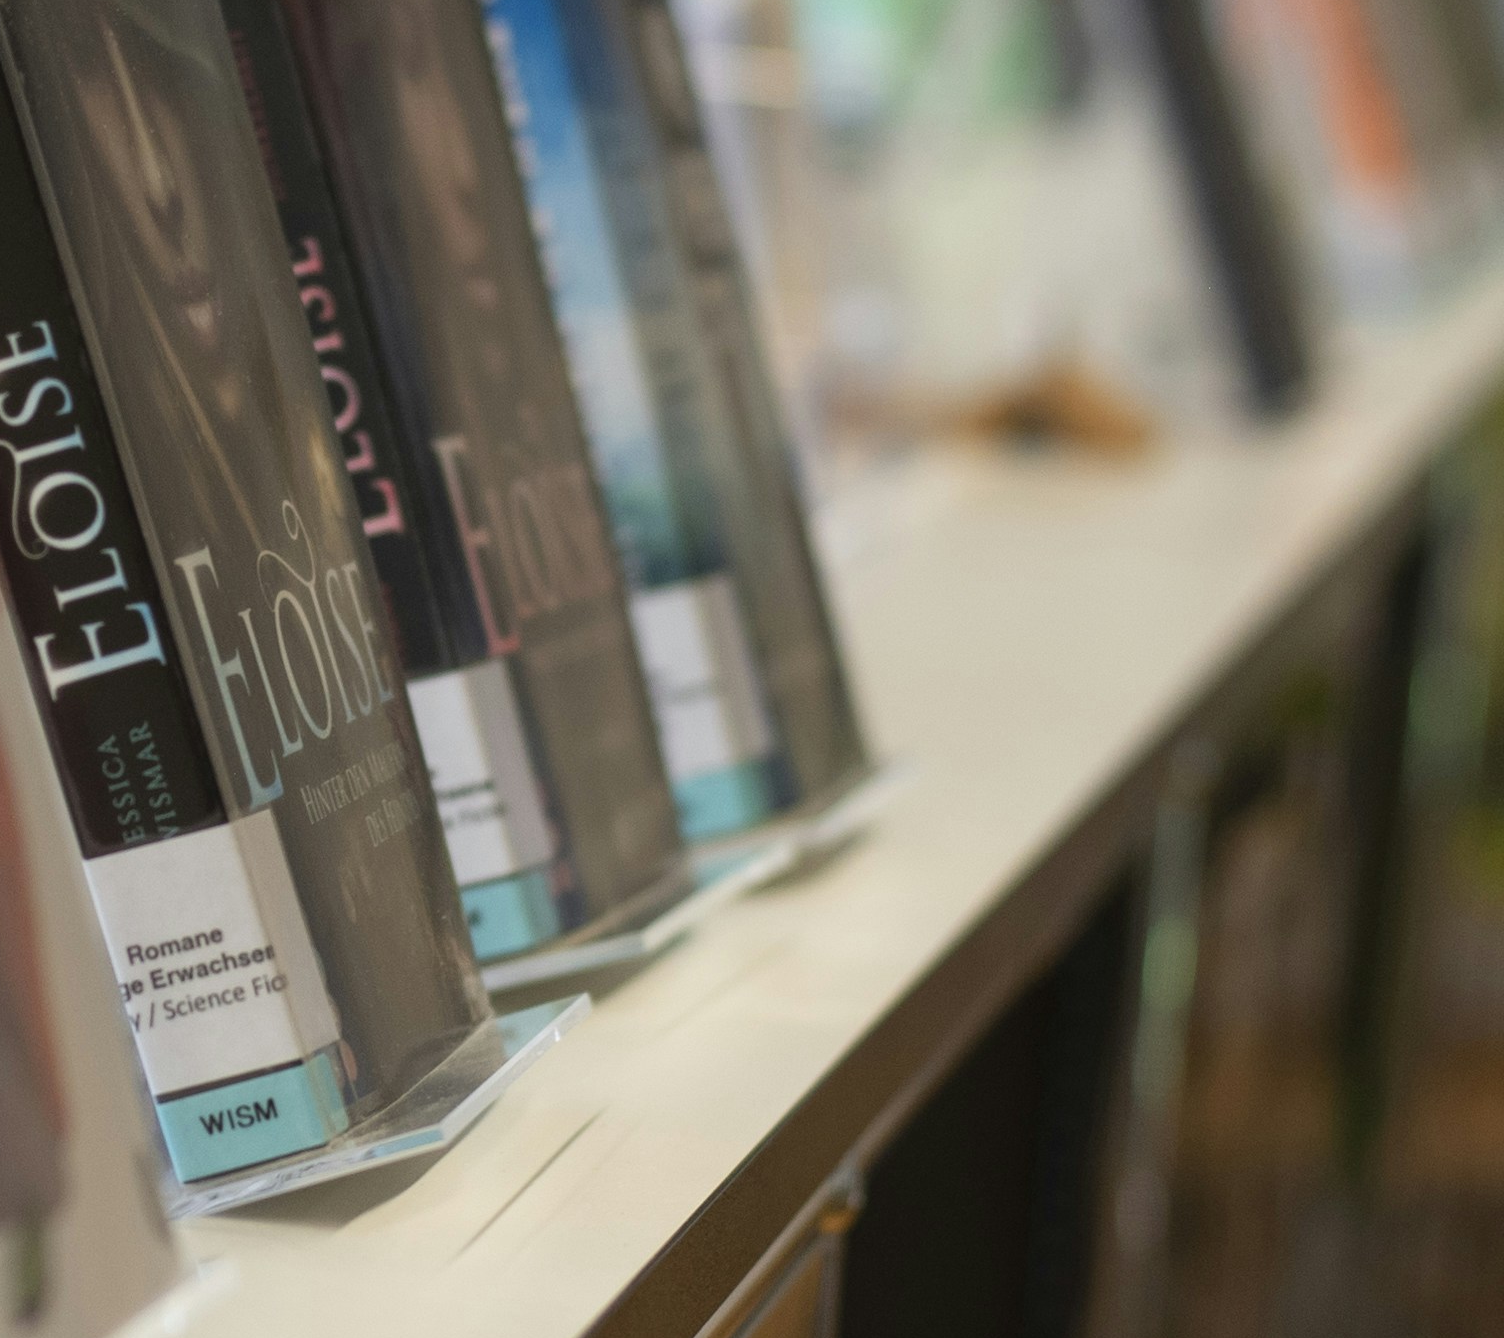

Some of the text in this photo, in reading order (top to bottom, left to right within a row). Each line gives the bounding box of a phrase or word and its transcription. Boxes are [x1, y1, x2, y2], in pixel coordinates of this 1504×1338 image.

[300, 775, 351, 825] HINTER
[125, 927, 224, 965] Romane
[162, 986, 246, 1021] Science
[199, 1097, 279, 1136] WISM
